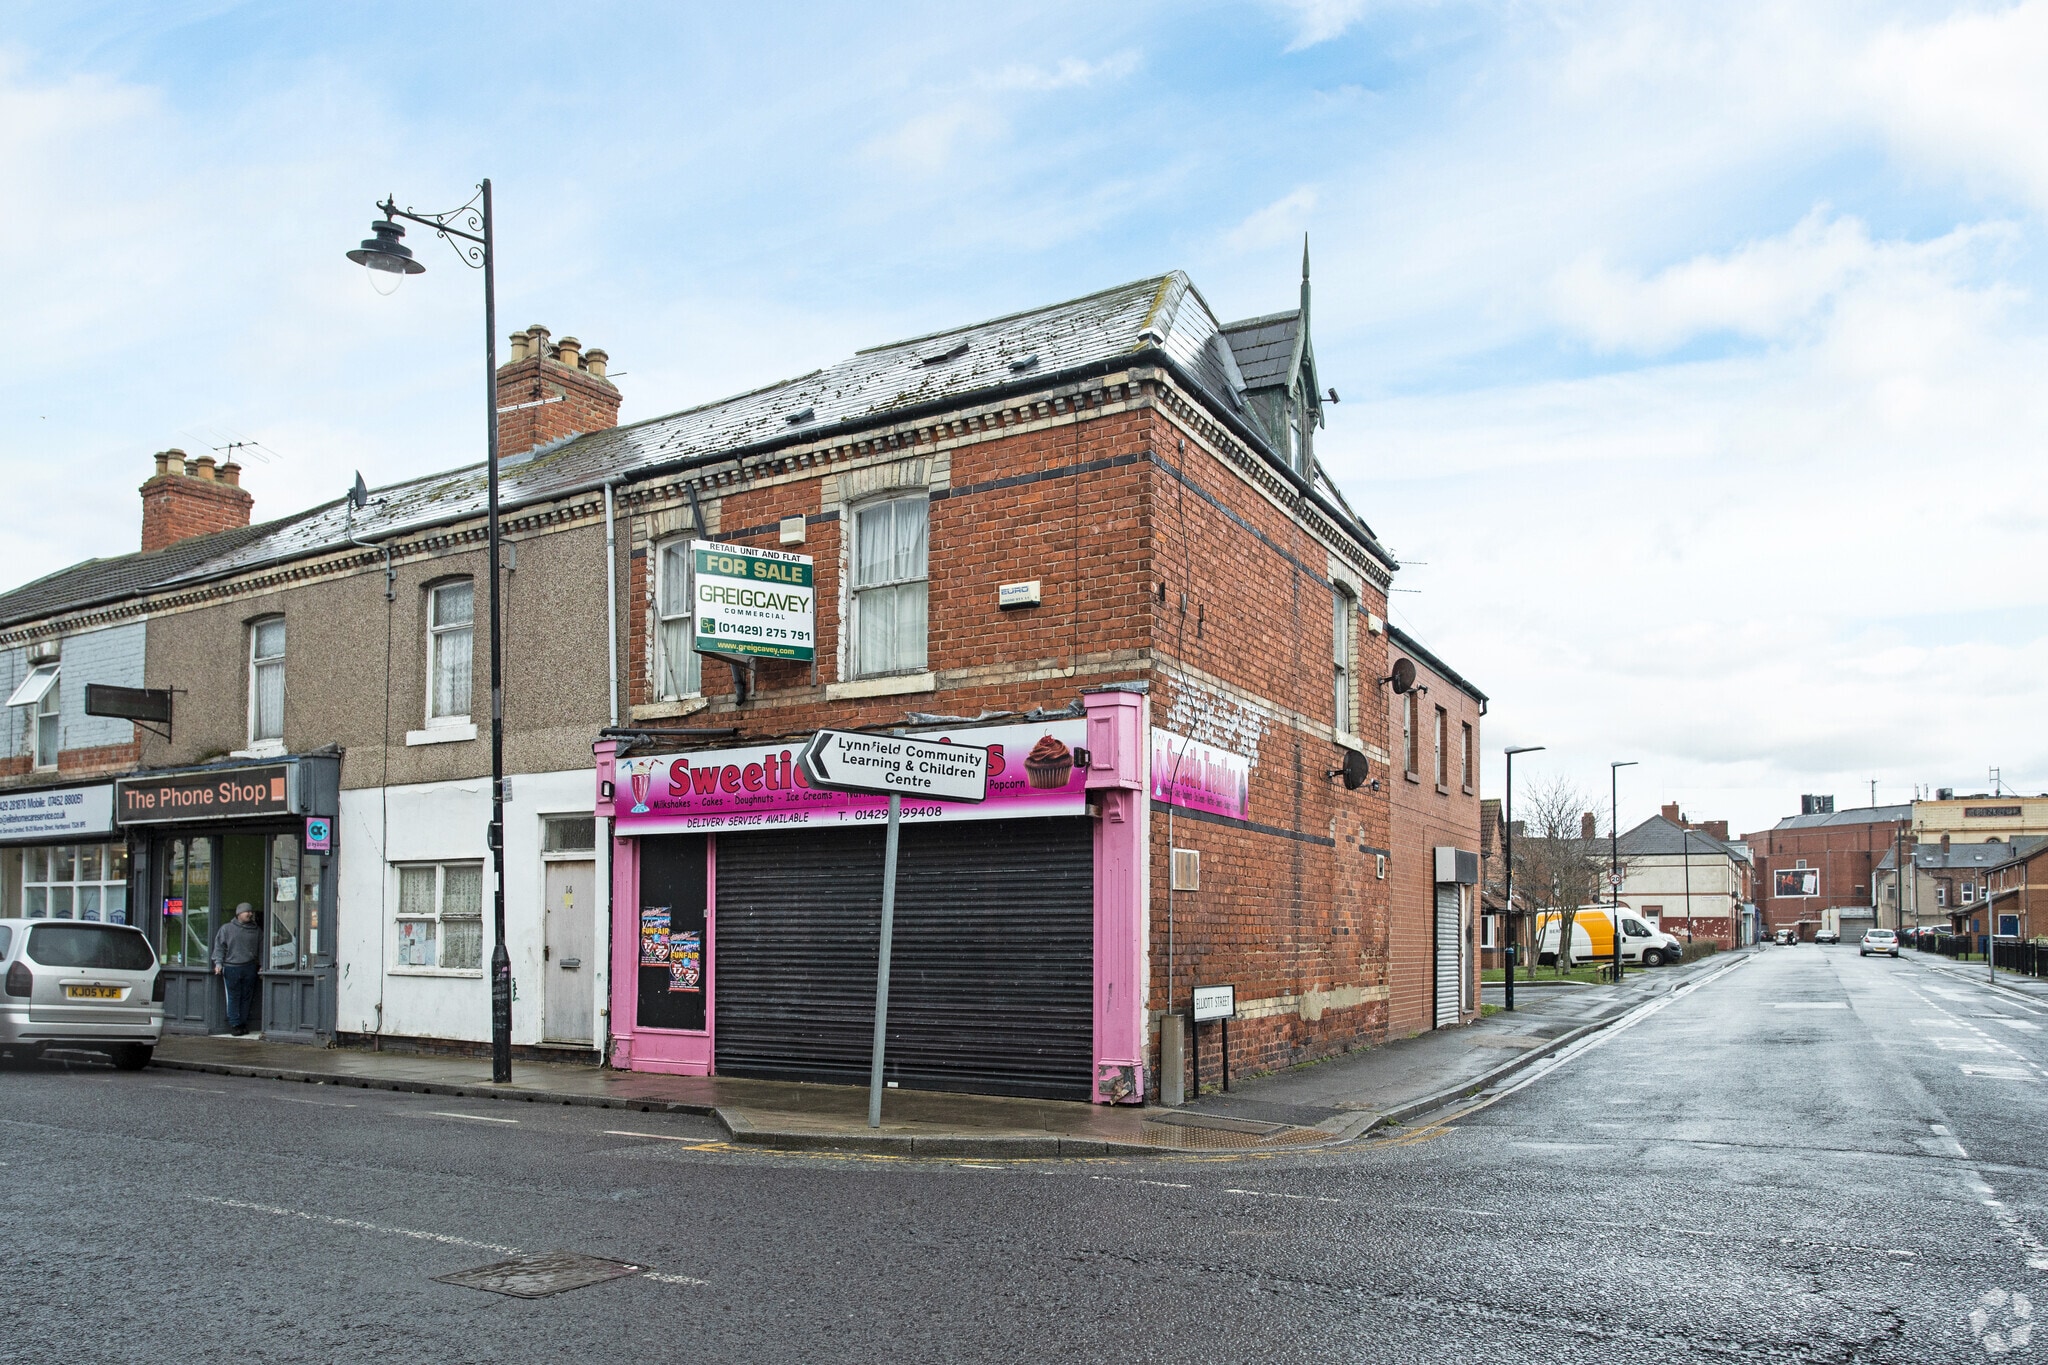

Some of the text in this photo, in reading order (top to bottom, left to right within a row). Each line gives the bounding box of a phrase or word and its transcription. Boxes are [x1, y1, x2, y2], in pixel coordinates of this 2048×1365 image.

[710, 543, 801, 562] RETAIL UNIT AND FLAT
[706, 555, 803, 582] FOR SALE
[700, 584, 809, 613] GREIGCAVEY
[725, 608, 785, 620] COMMERCIAL
[719, 622, 810, 641] (01429) 275 791
[717, 642, 795, 655] www.greigcavey.com
[906, 746, 982, 766] Community
[843, 753, 976, 778] Learning & Children
[885, 772, 931, 787] Centre
[990, 779, 1026, 790] Popcorn
[125, 782, 266, 809] The Phone Shop
[653, 798, 691, 809] Milkshakes
[702, 796, 723, 807] Cakes
[735, 794, 774, 807] Doughnuts
[786, 792, 800, 802] Ice
[803, 790, 833, 801] Creams
[687, 812, 809, 828] DELIVERY SERVICE AVAILABLE
[838, 812, 848, 822] T.
[855, 808, 889, 821] 01429
[642, 927, 669, 935] FUNFAIR
[643, 942, 653, 950] 17
[655, 948, 668, 956] 27
[99, 988, 117, 997] YJF
[1215, 995, 1230, 1008] STREET
